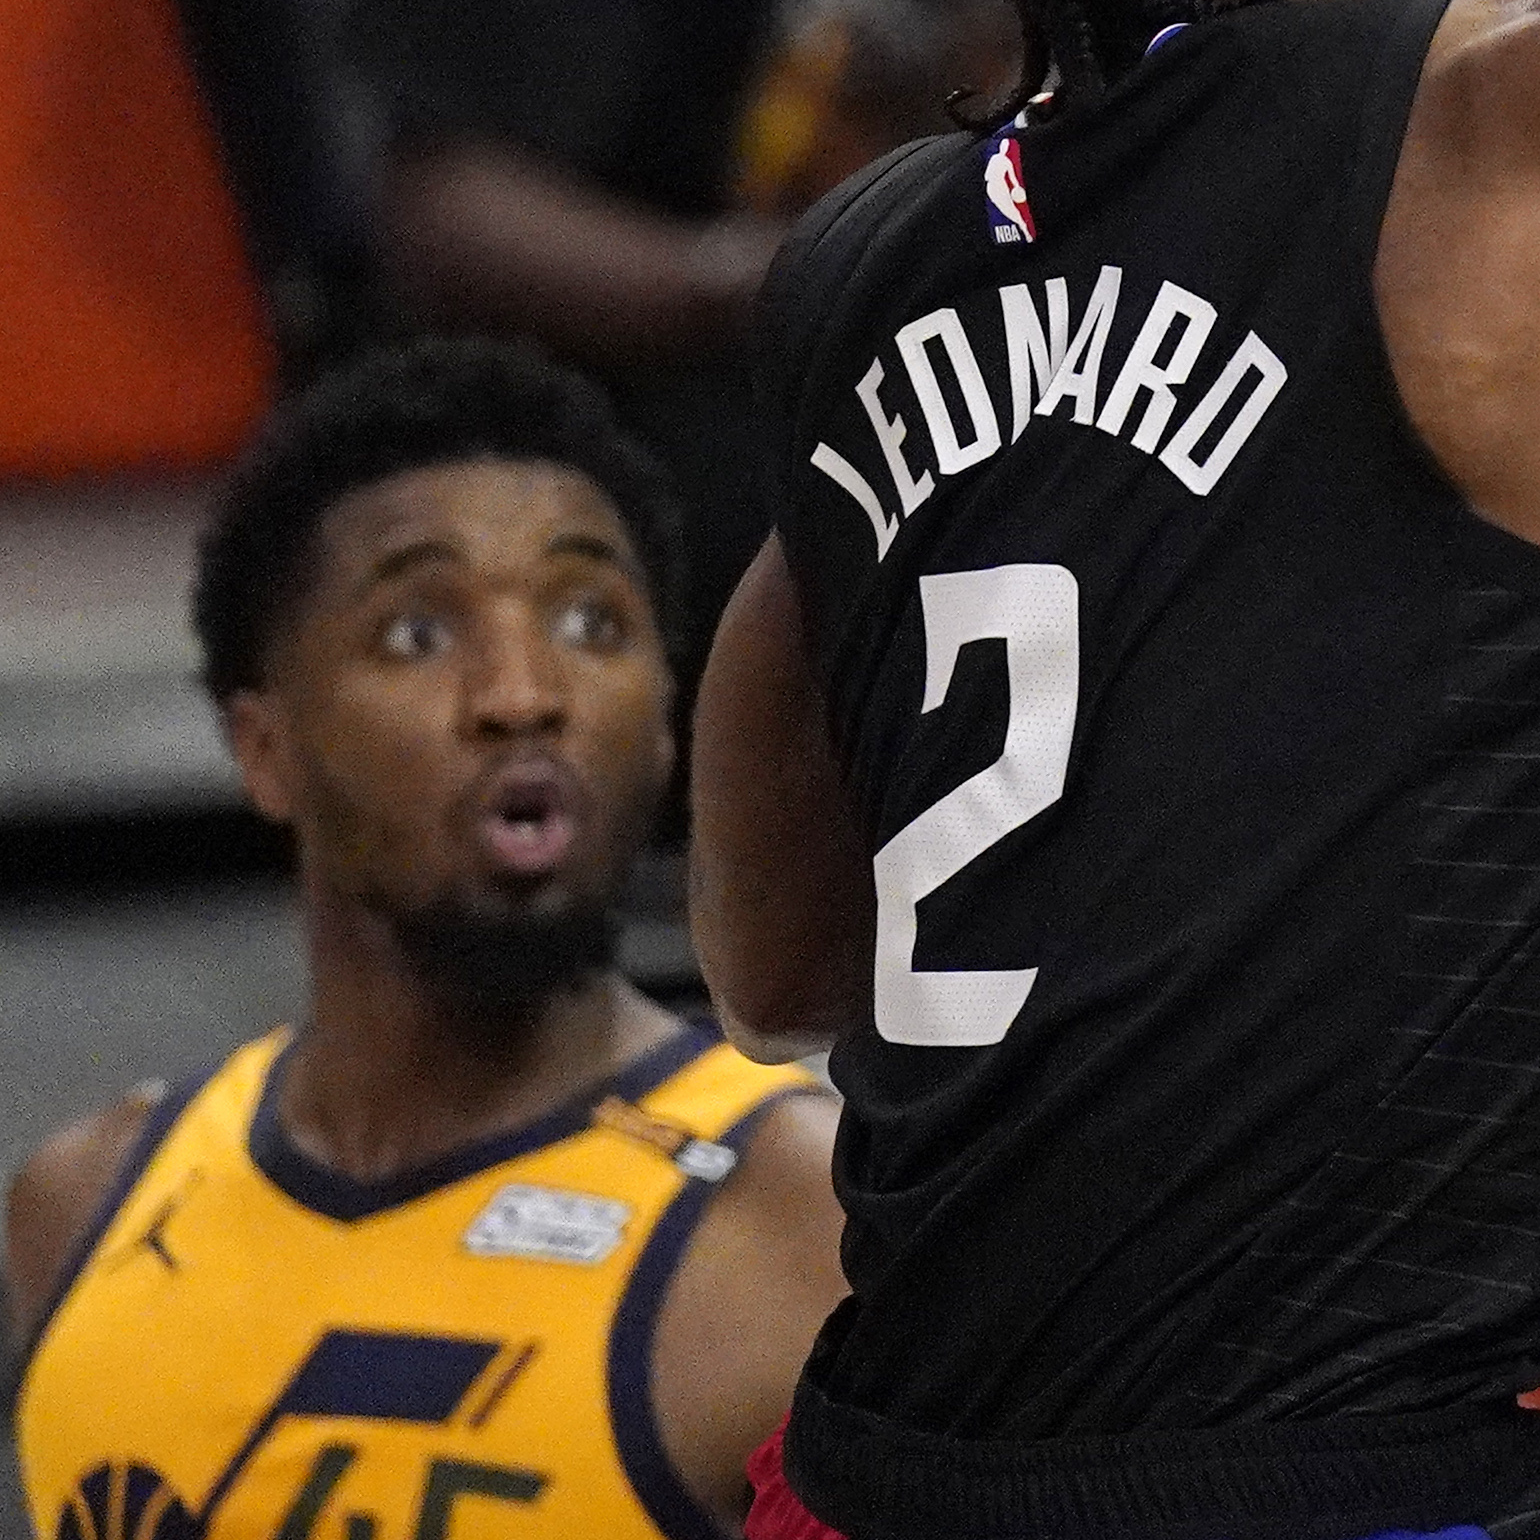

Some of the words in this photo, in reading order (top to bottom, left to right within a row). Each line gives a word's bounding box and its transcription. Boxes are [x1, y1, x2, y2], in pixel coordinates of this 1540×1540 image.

[995, 224, 1021, 244] NBA
[810, 265, 1288, 562] LEONARD
[874, 563, 1079, 1045] 2
